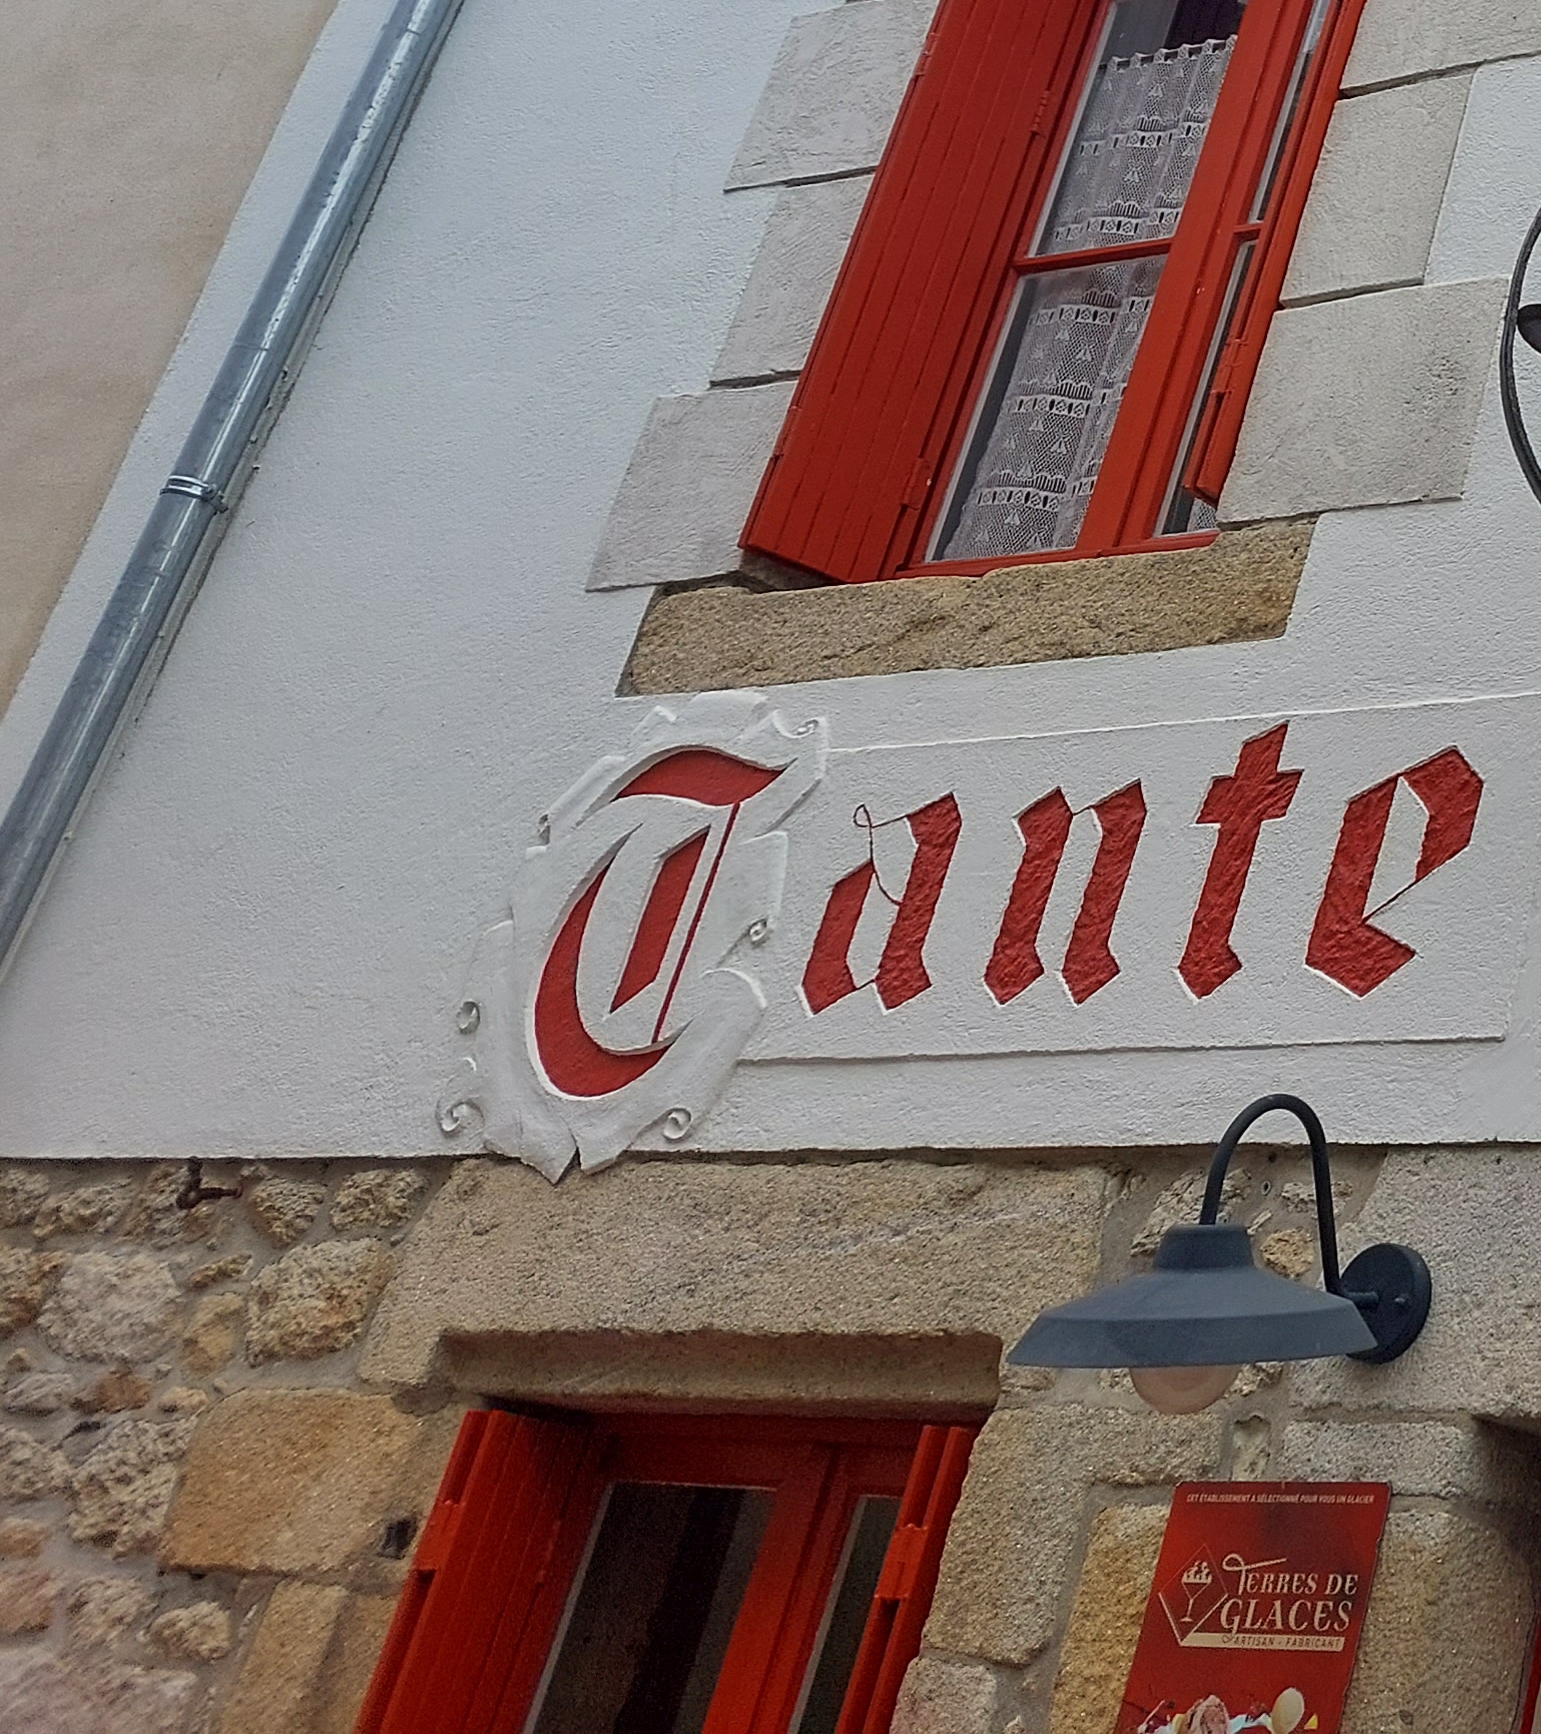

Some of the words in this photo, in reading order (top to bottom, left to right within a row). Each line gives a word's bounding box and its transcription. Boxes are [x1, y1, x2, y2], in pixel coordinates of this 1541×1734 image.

[533, 720, 1484, 1097] Tante
[1324, 1573, 1359, 1596] DE
[1220, 1598, 1353, 1644] GLACES
[1234, 1636, 1274, 1647] ARTISAN
[1286, 1637, 1342, 1649] FABRICANT
